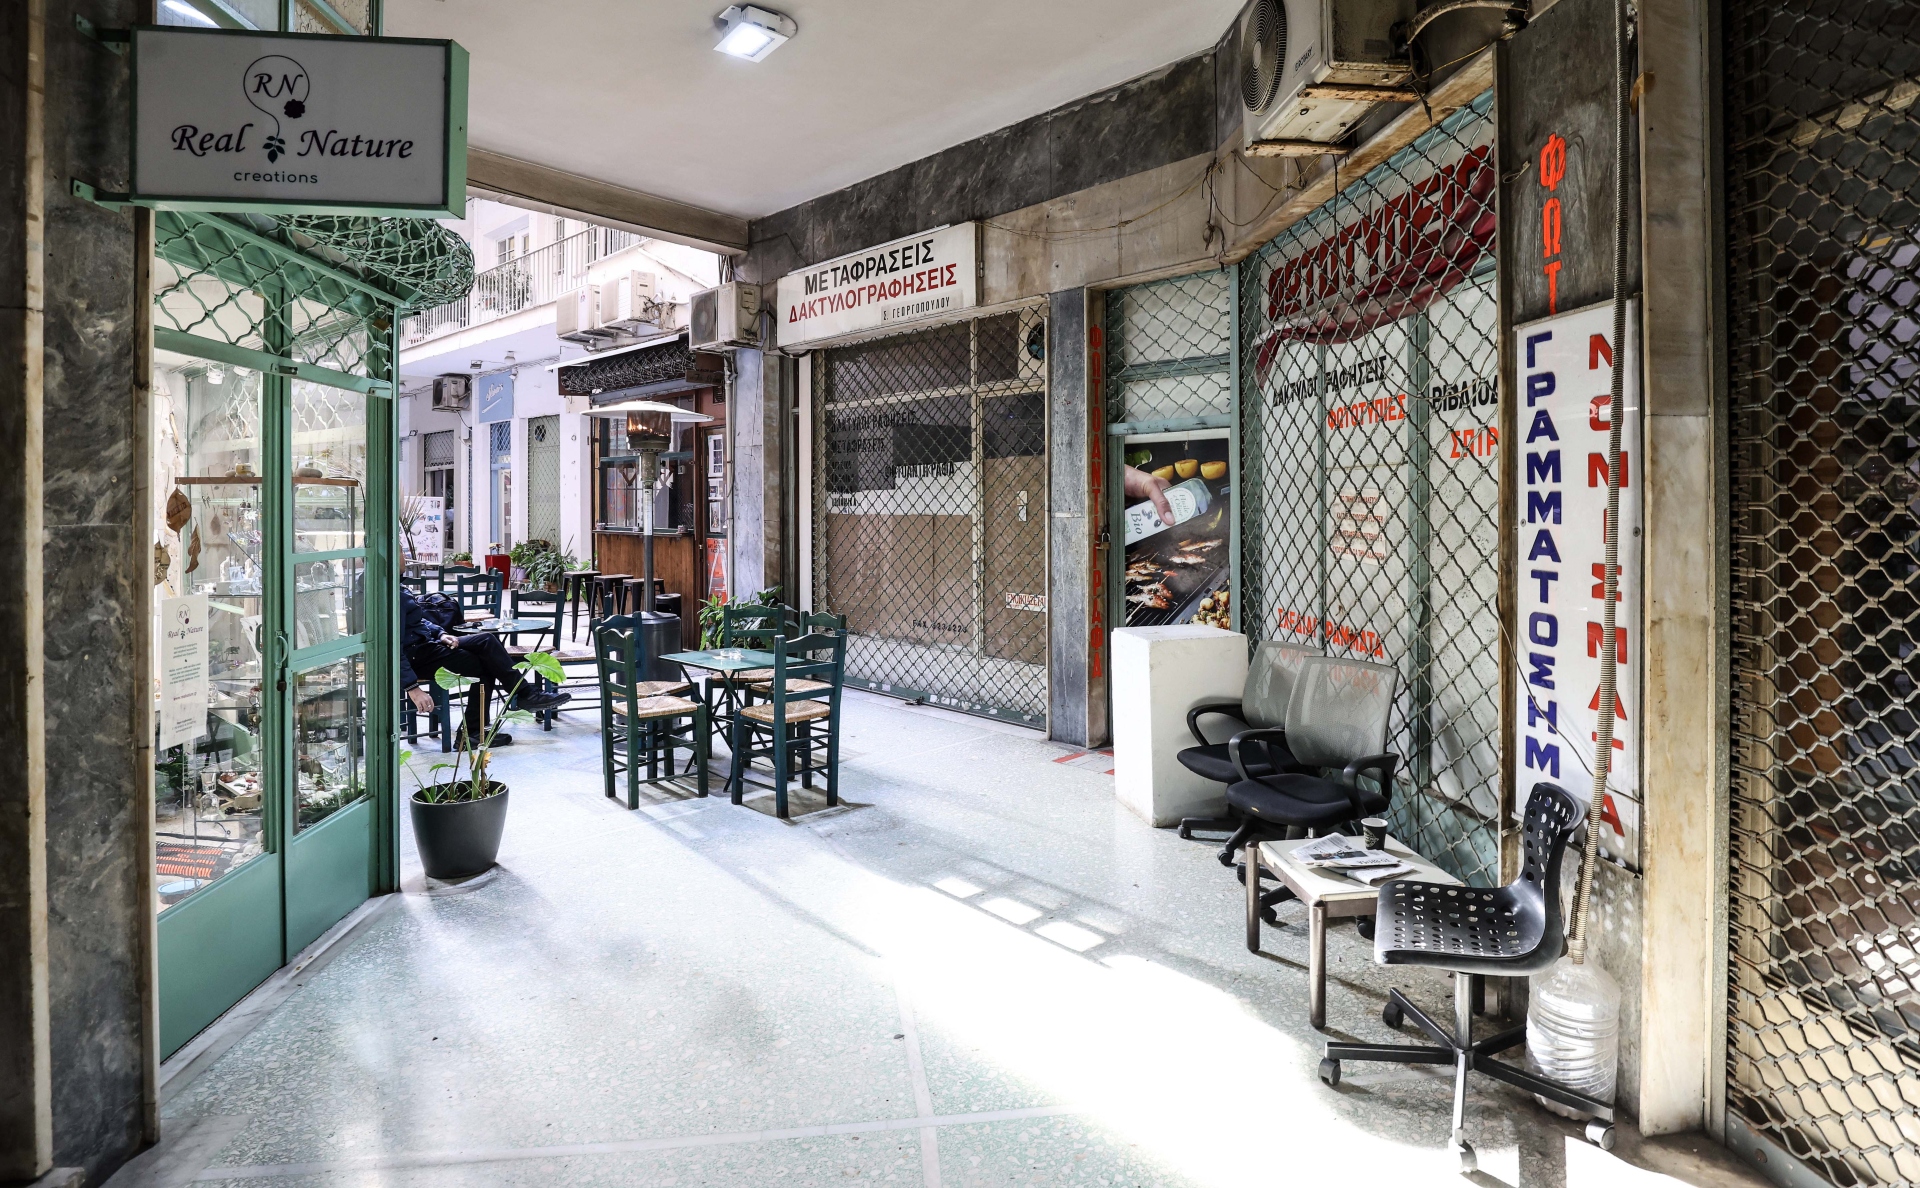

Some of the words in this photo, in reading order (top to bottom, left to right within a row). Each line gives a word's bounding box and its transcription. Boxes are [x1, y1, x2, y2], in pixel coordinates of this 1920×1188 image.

[252, 72, 304, 99] RN
[171, 123, 253, 157] Real
[297, 129, 415, 160] Nature
[233, 170, 319, 185] creations
[805, 239, 935, 296] ΜΕΤΑΦΡΑΣΕΙΣ
[789, 263, 957, 324] ΔΑΚΤΥΛΟΓΡΑΦΗΣΕΙΣ
[883, 310, 889, 321] Σ.
[892, 296, 950, 319] ΓΕΩΡΓΟΠΟΥΛΟΥ
[1327, 394, 1406, 431] ΦΩΤΟΤΥΠΙΕΣ
[1130, 513, 1142, 534] Bio
[1525, 330, 1562, 782] ΓΡΑΜΜΑΤΟΣΗΜ
[167, 628, 179, 639] Real
[186, 626, 203, 636] Nature
